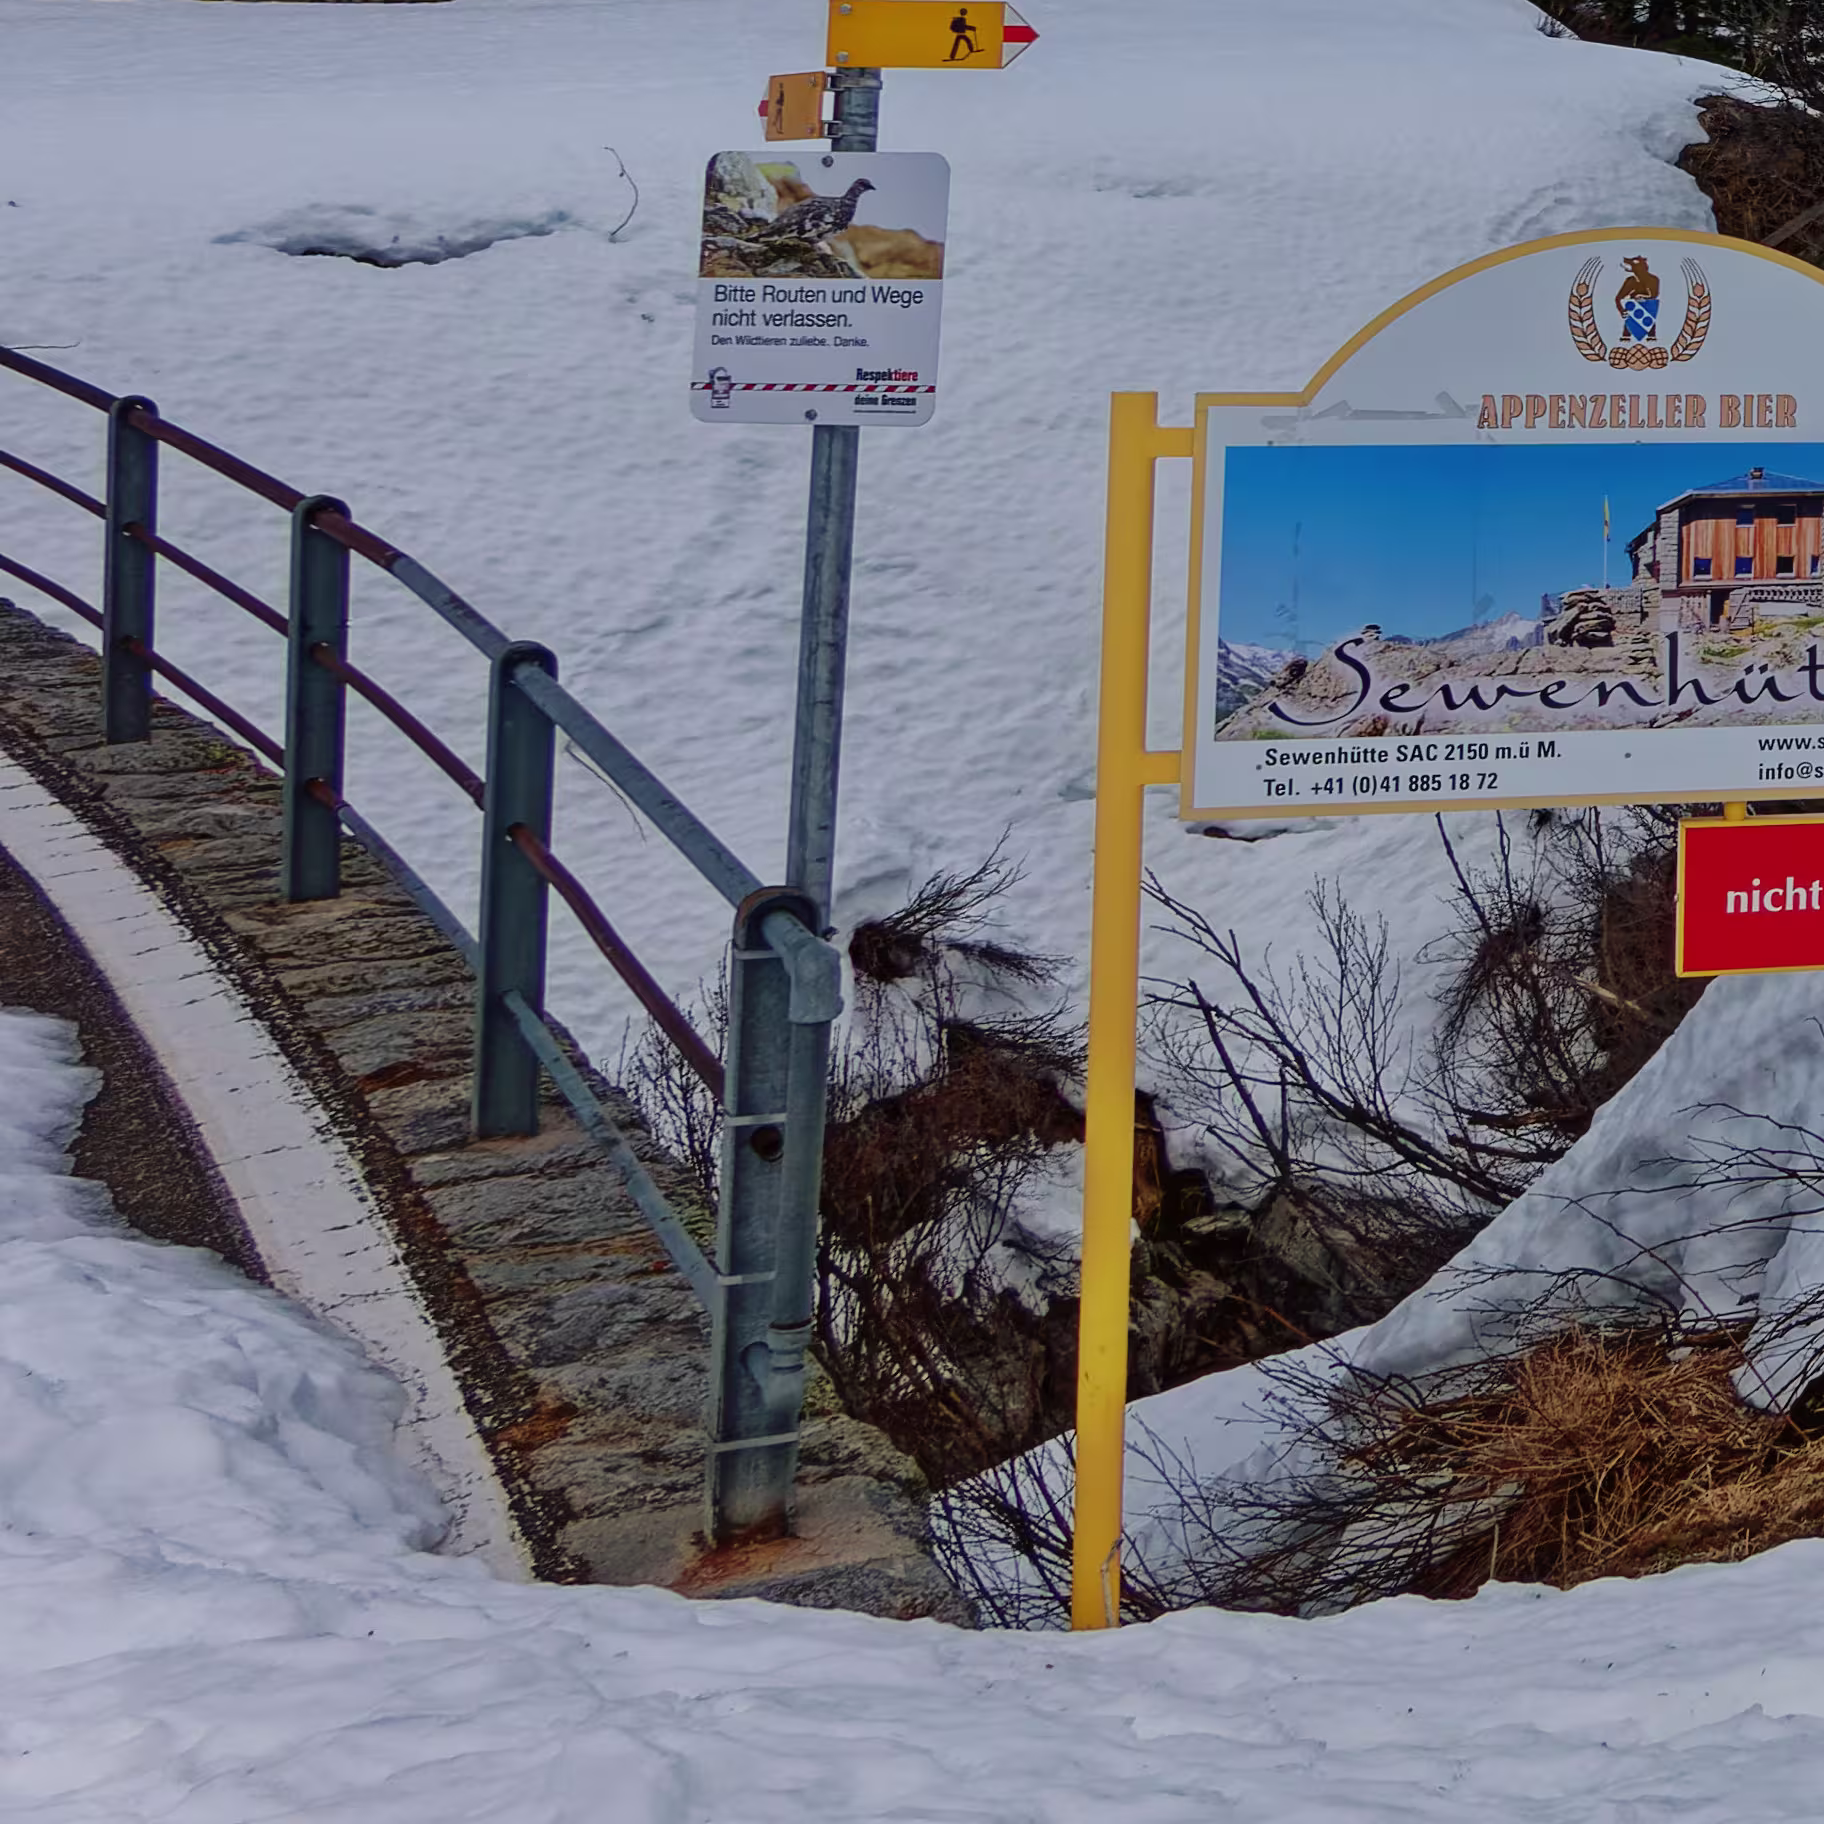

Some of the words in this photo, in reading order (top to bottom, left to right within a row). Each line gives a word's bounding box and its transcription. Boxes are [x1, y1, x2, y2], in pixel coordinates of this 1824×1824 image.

[714, 284, 756, 303] Bitte
[762, 285, 826, 303] Routen
[832, 286, 866, 303] und
[872, 286, 924, 308] Wege
[712, 309, 757, 327] nicht
[763, 309, 853, 327] verlassen.
[711, 334, 732, 345] Den
[735, 335, 787, 346] Wildtieren
[789, 336, 831, 347] zuliebe.
[833, 337, 870, 348] Danke.
[855, 368, 919, 383] Respektiere
[854, 394, 879, 406] deine
[881, 394, 917, 407] Grenzen
[1477, 393, 1707, 429] APPENZELLER
[1719, 393, 1798, 429] BIER
[1264, 745, 1389, 766] Sewenhütte
[1396, 743, 1438, 762] SAC
[1444, 742, 1489, 761] 2150
[1495, 740, 1530, 760] m.ü
[1537, 740, 1562, 759] M.
[1263, 778, 1301, 797] Tel.
[1310, 777, 1344, 795] +41
[1352, 775, 1401, 797] (0)41
[1408, 774, 1442, 793] 885
[1449, 773, 1470, 791] 18
[1476, 772, 1499, 790] 72
[1725, 876, 1824, 914] nicht
